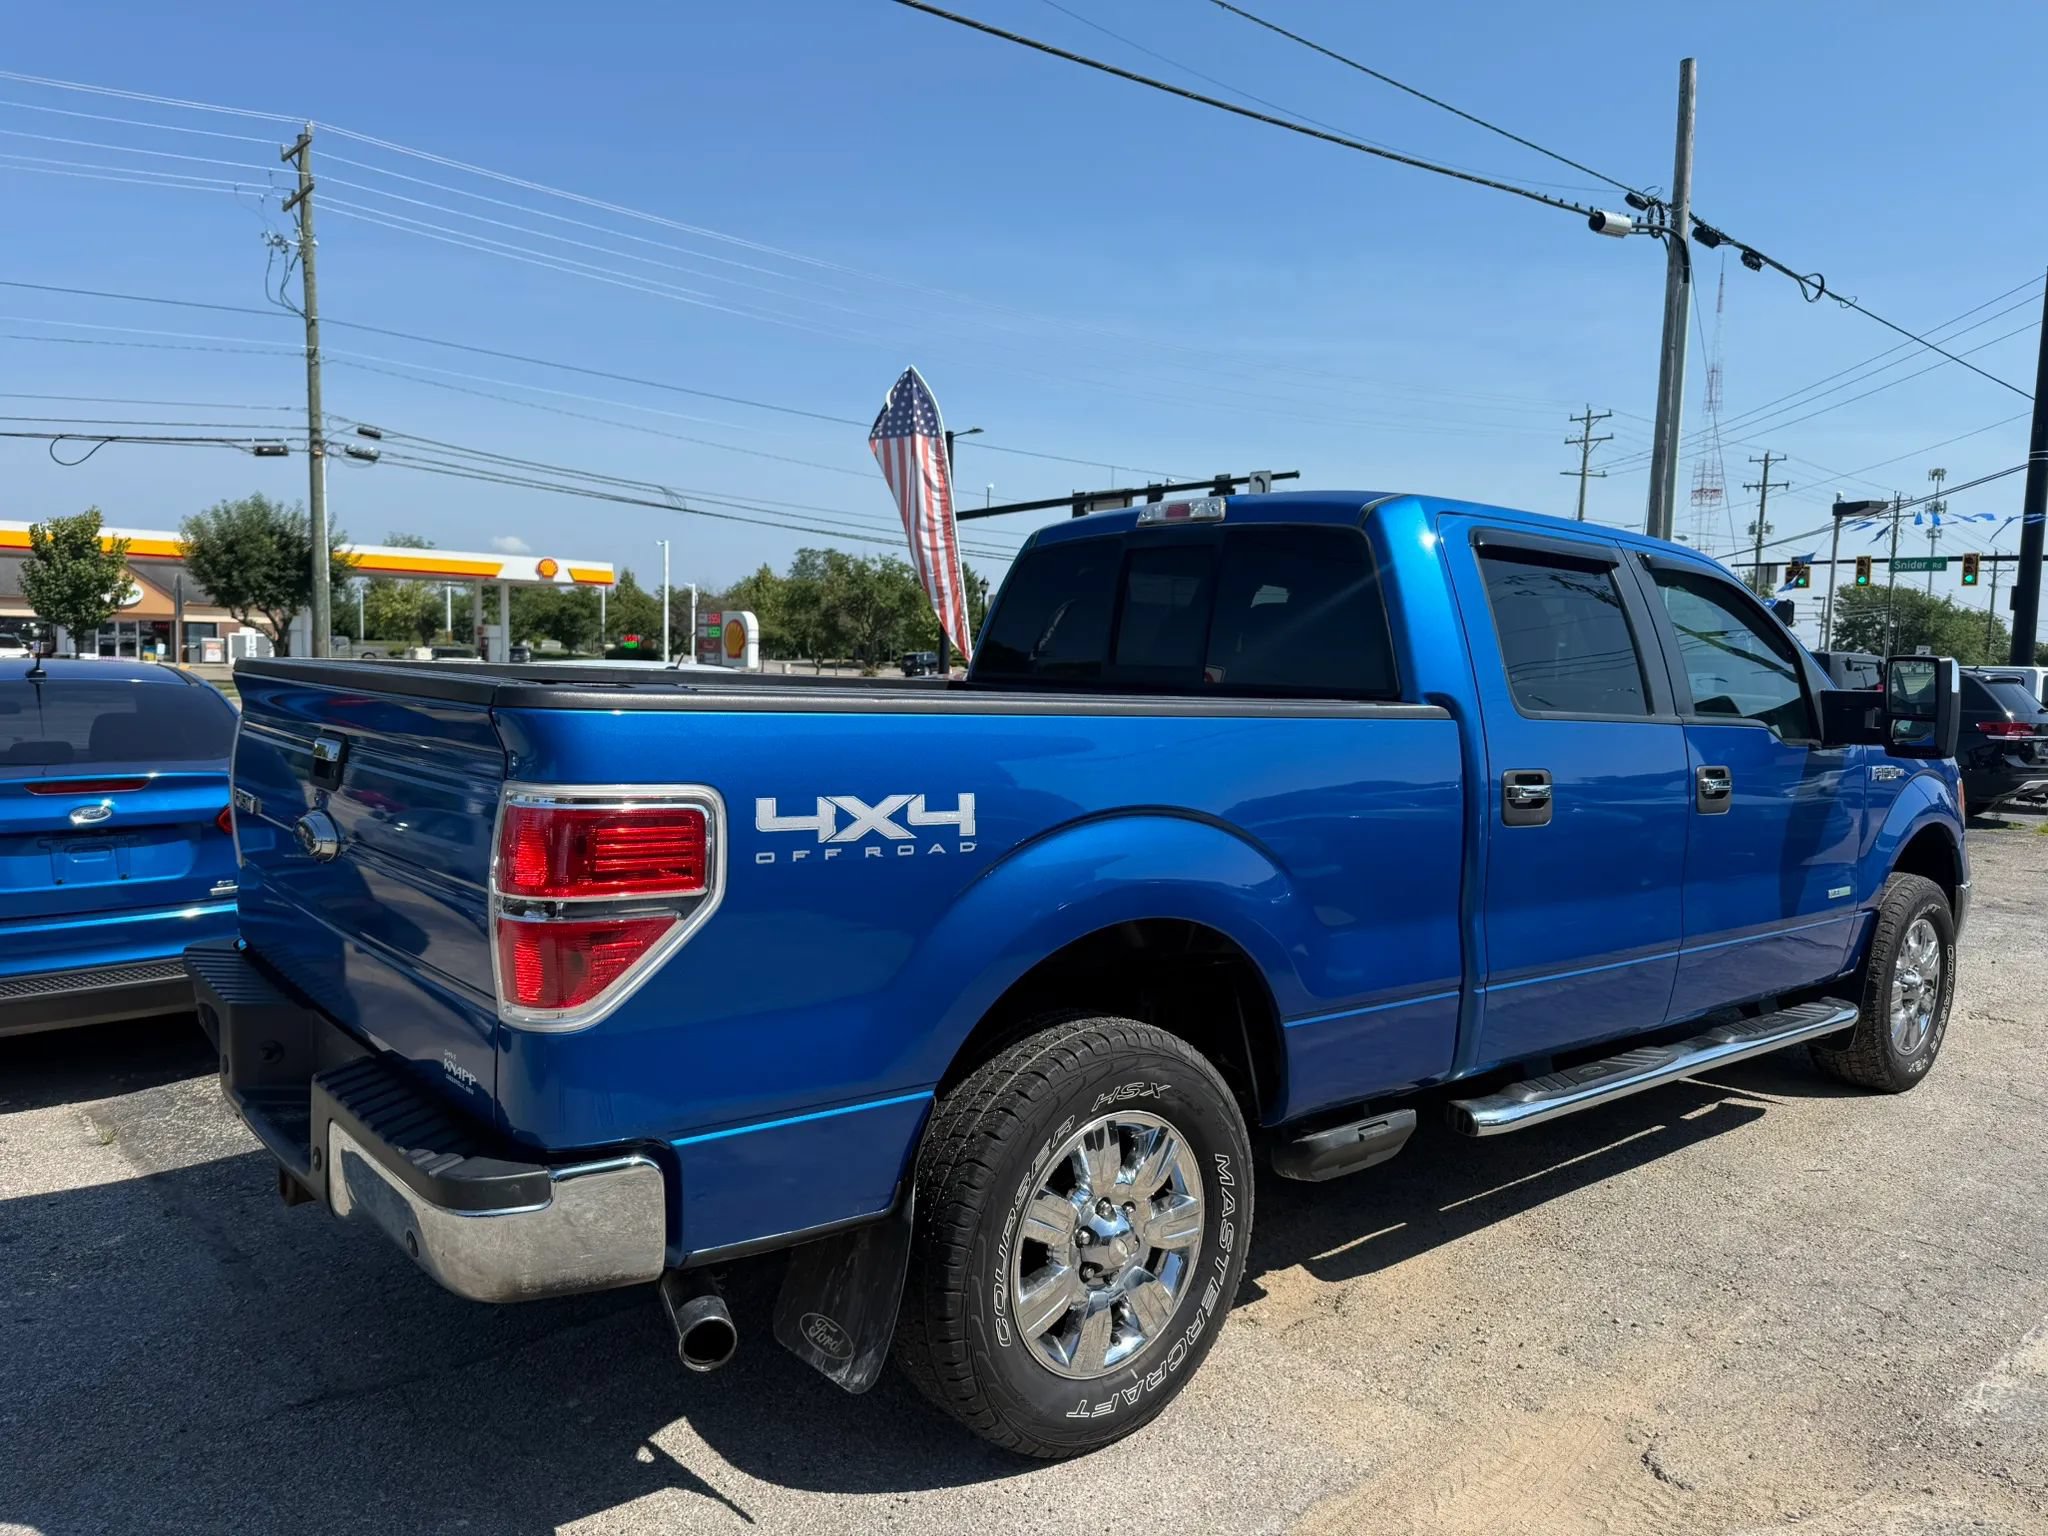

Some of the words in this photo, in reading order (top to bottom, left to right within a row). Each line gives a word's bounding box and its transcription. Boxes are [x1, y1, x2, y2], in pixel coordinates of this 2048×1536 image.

[1894, 560, 1927, 570] Snider
[444, 1058, 477, 1086] KNAPP
[993, 1115, 1076, 1347] COURSER
[1092, 1081, 1171, 1112] HSX
[1066, 1153, 1236, 1418] MASTERCRAFT
[808, 1318, 844, 1353] Ford
